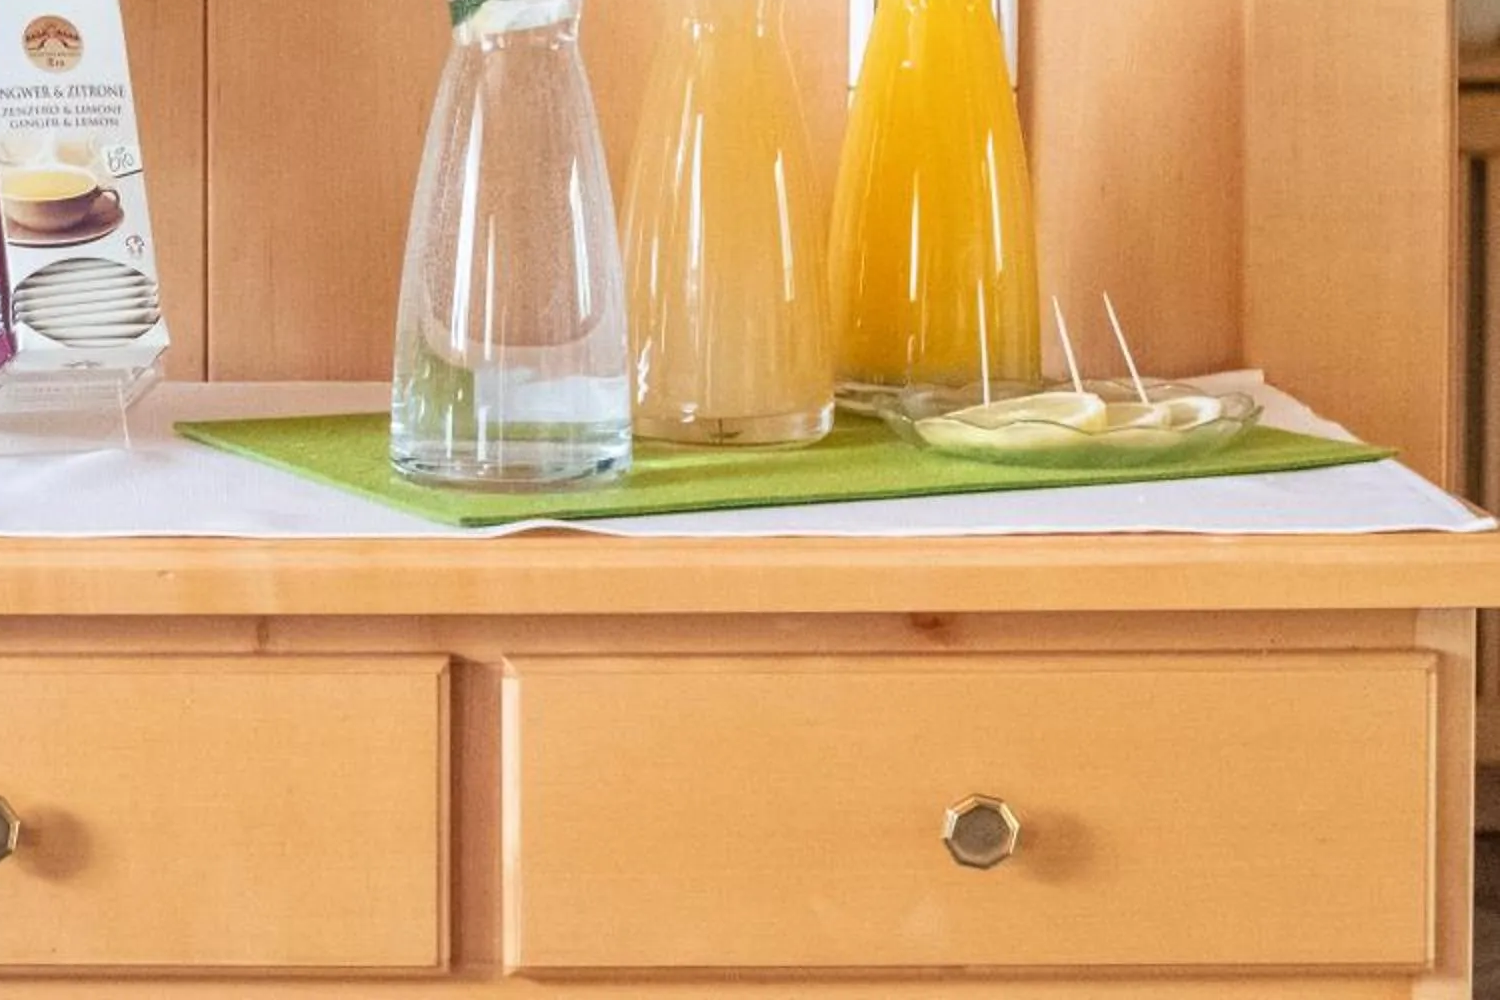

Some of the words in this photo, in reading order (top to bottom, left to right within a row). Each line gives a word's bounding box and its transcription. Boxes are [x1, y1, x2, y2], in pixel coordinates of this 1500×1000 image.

[53, 85, 63, 98] &
[67, 83, 125, 98] ZITRONE
[75, 104, 122, 115] LIMONE
[9, 118, 59, 129] GINGER
[75, 117, 119, 127] LEMON
